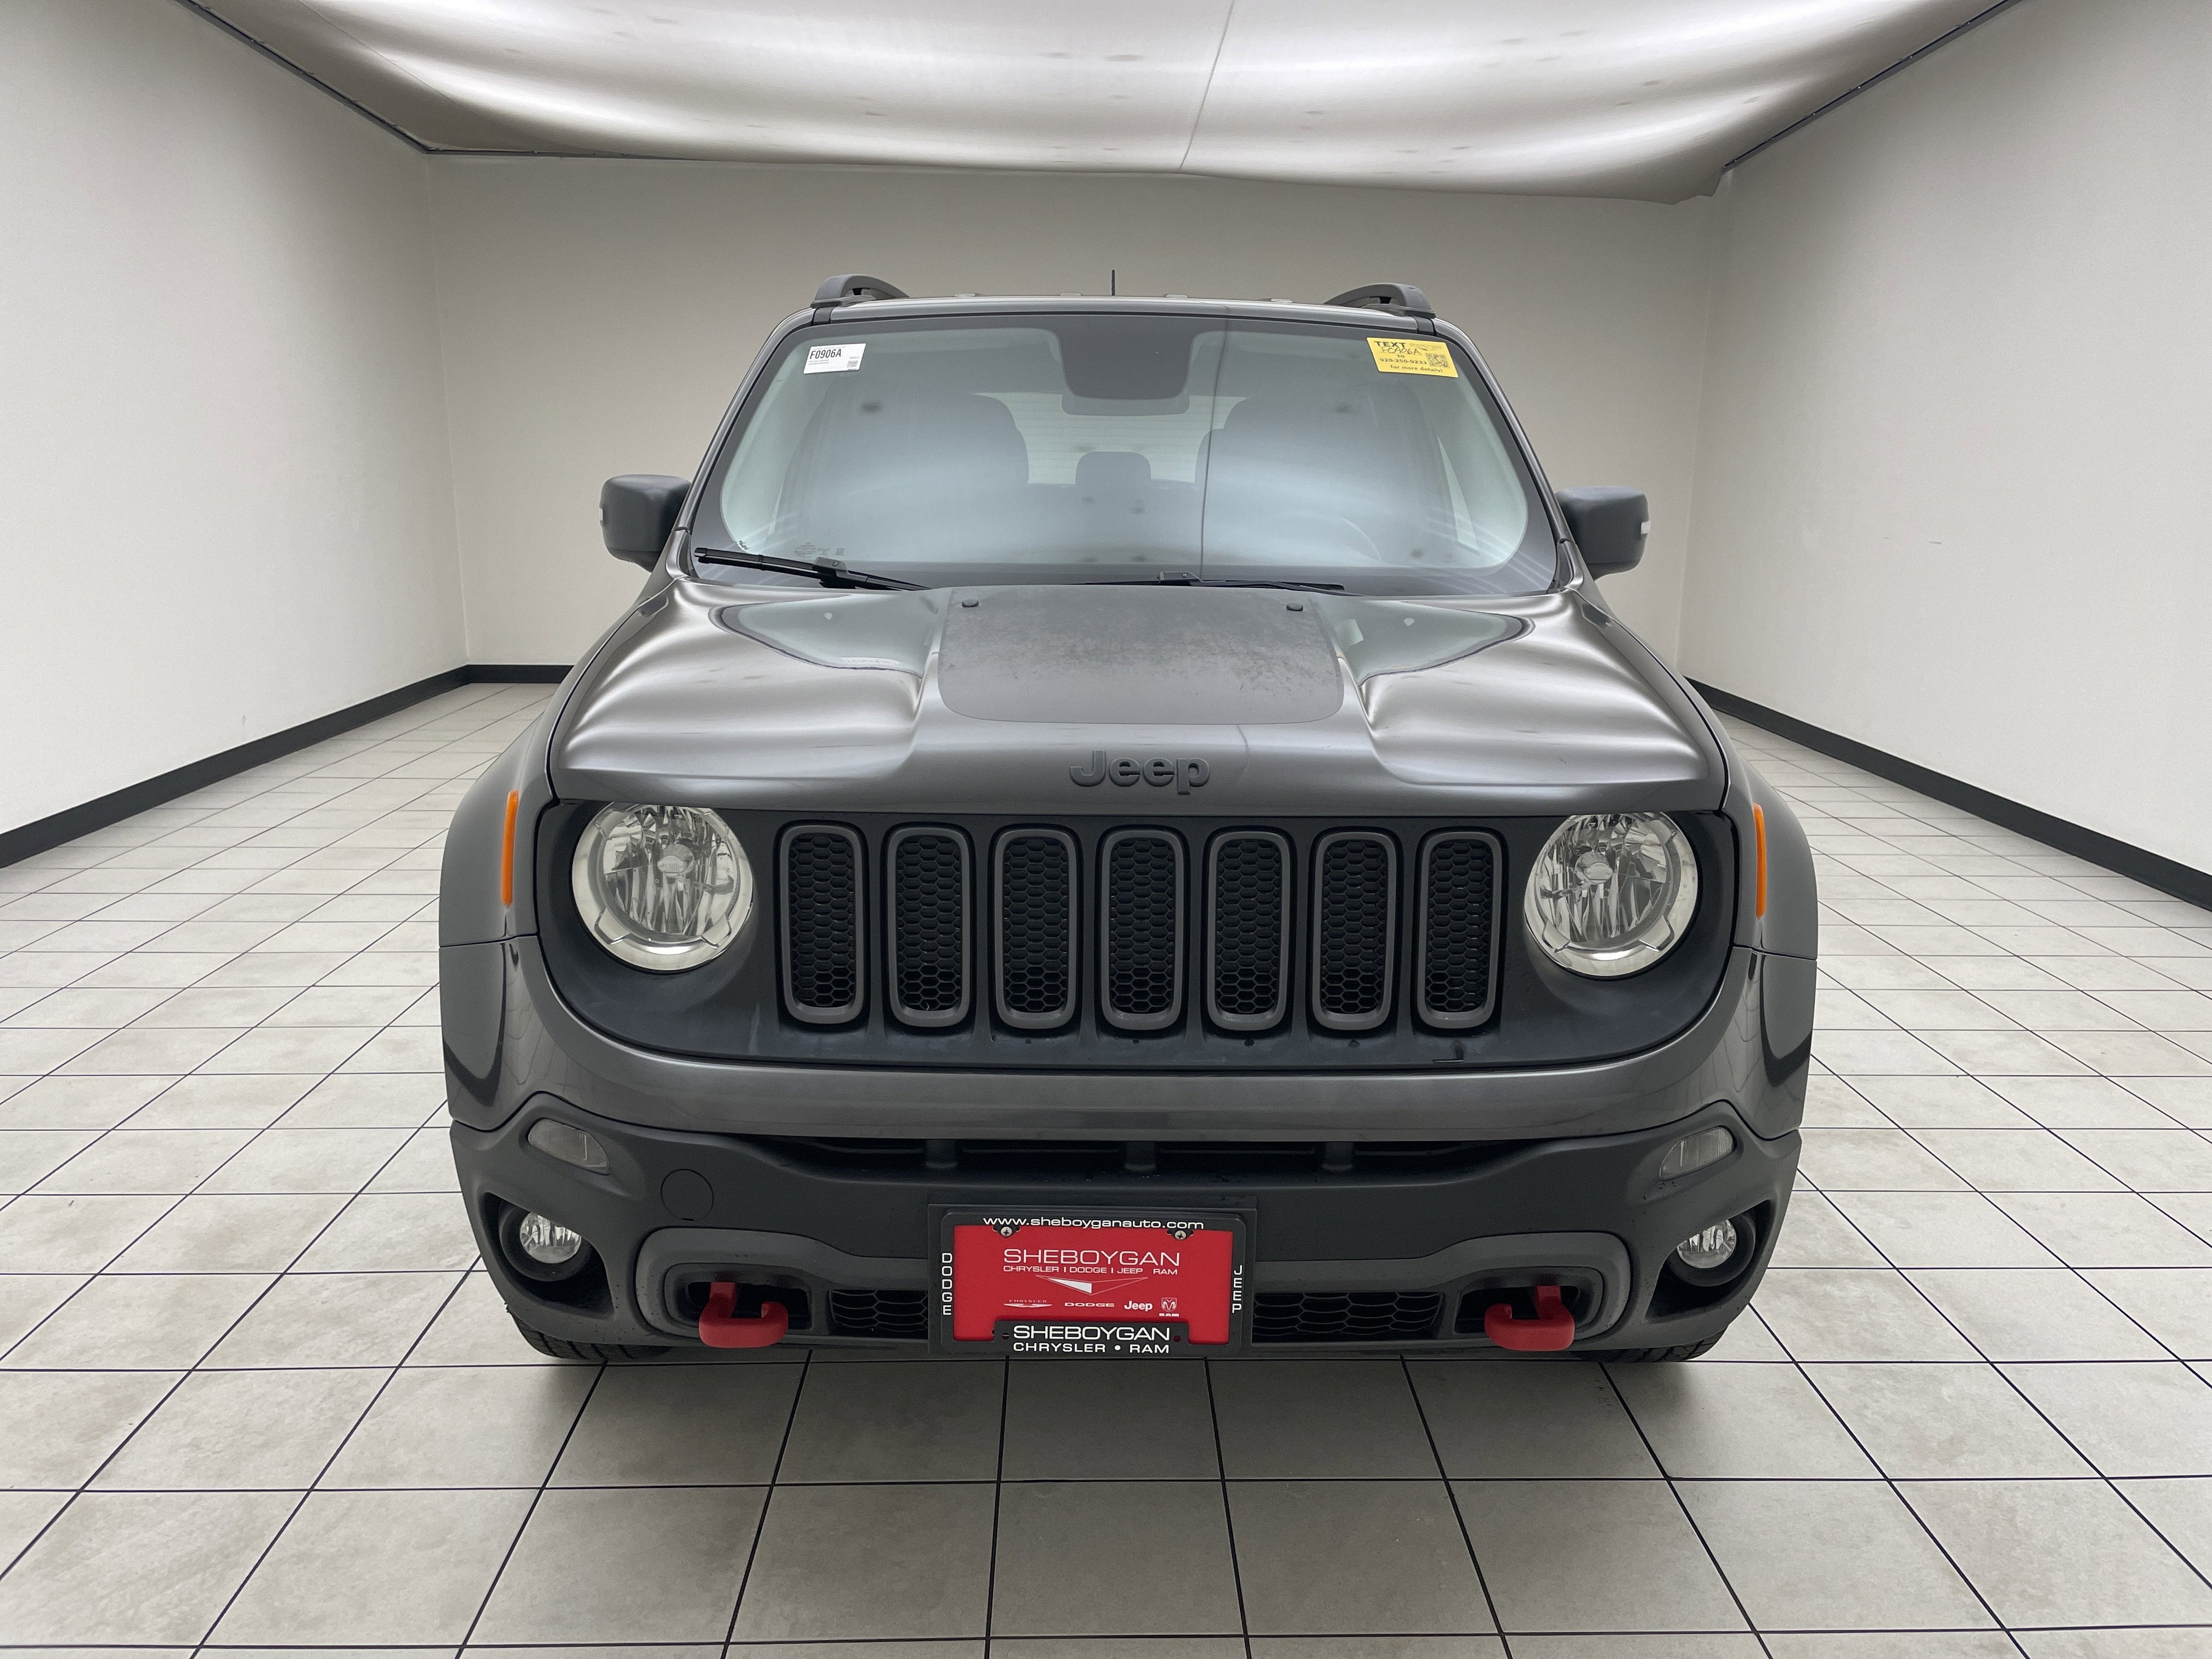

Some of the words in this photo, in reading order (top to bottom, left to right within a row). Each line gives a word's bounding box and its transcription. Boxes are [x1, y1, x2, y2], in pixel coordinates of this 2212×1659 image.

[809, 348, 842, 359] F0906A
[1070, 750, 1210, 795] Jeep
[983, 1216, 1204, 1230] www.sheboyganauto.com
[1003, 1248, 1180, 1266] SHEBOYGAN
[942, 1252, 953, 1315] DODGE
[1232, 1265, 1243, 1313] JEEP
[1124, 1300, 1153, 1312] Jeep
[1013, 1325, 1170, 1341] SHEBOYGAN
[1013, 1342, 1105, 1352] CHRYSLER
[1129, 1344, 1170, 1353] RAM
